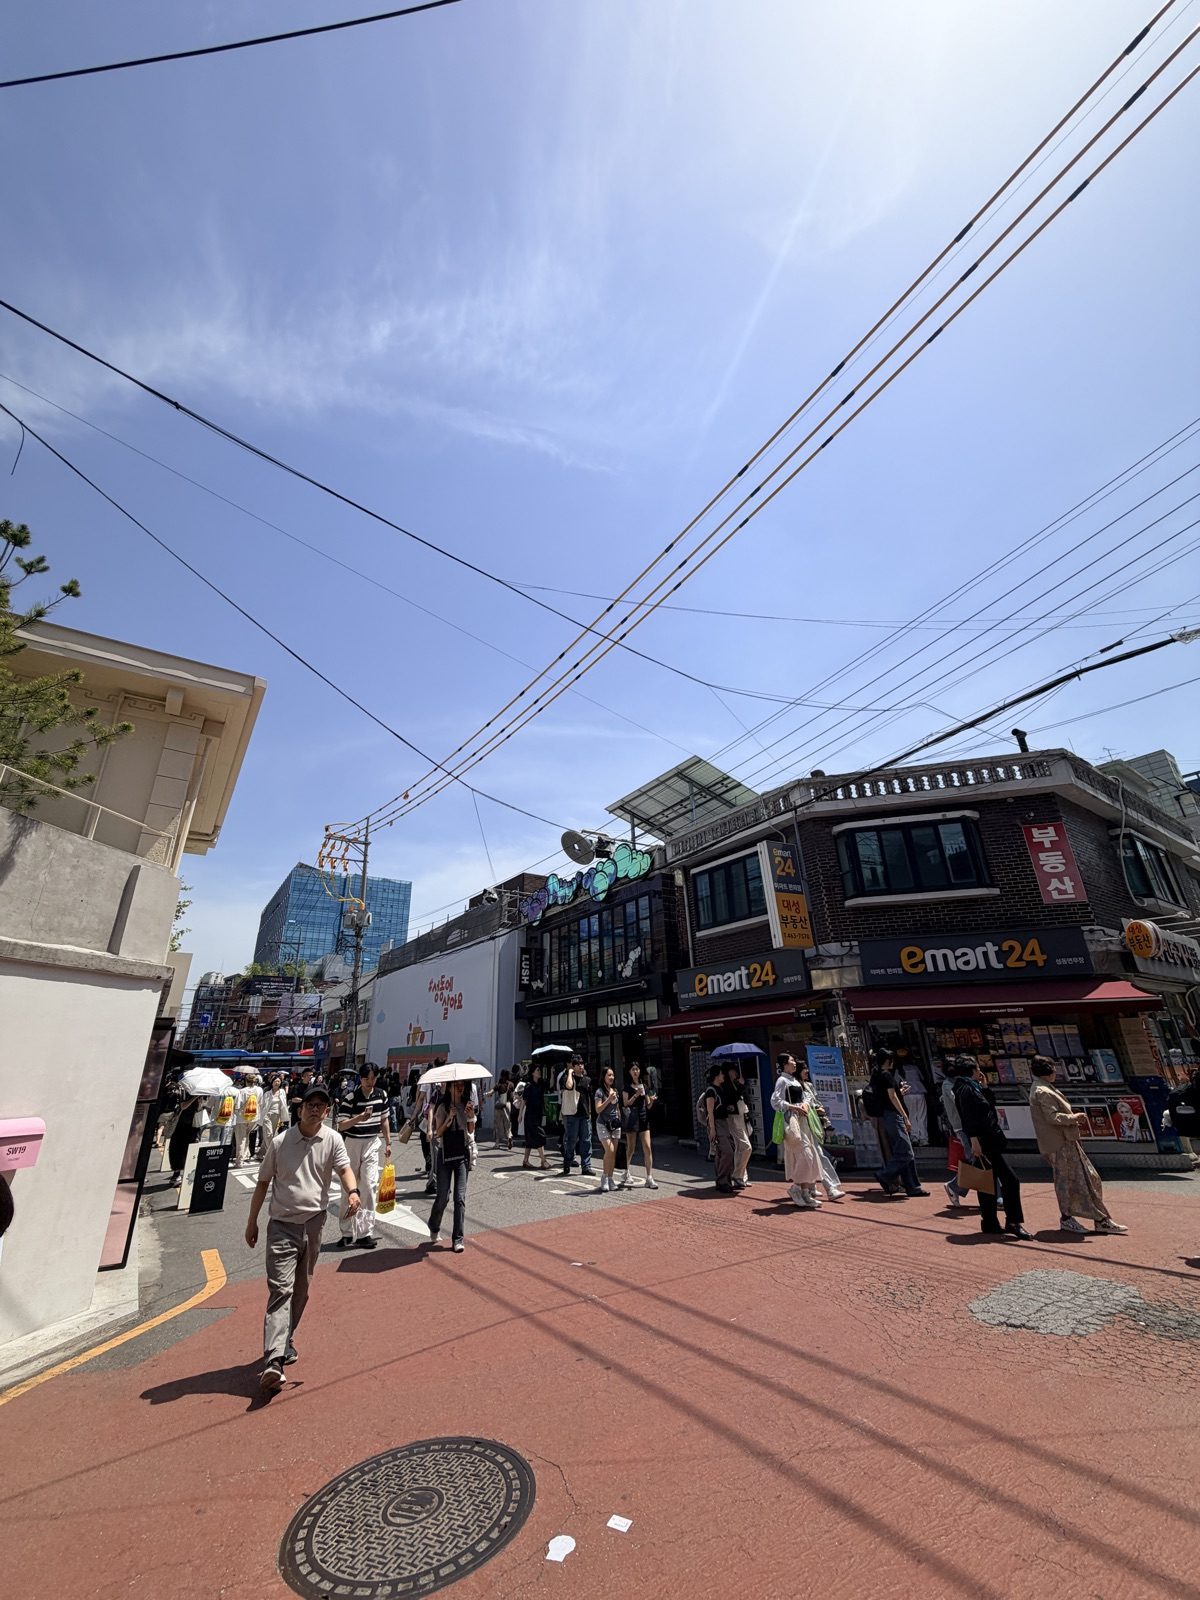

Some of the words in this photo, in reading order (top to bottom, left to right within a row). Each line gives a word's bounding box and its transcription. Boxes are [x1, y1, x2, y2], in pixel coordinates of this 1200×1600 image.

[772, 847, 792, 858] emart
[775, 857, 796, 878] 24
[1031, 826, 1076, 900] 부동산
[782, 899, 801, 914] 대성
[780, 914, 808, 929] 부동산
[1129, 934, 1152, 951] 부동산
[900, 938, 1048, 974] emart24
[521, 954, 530, 985] LUSH
[694, 960, 776, 997] emart24
[607, 1011, 637, 1028] LUSH
[6, 1145, 27, 1156] SW19
[205, 1148, 224, 1157] SW19
